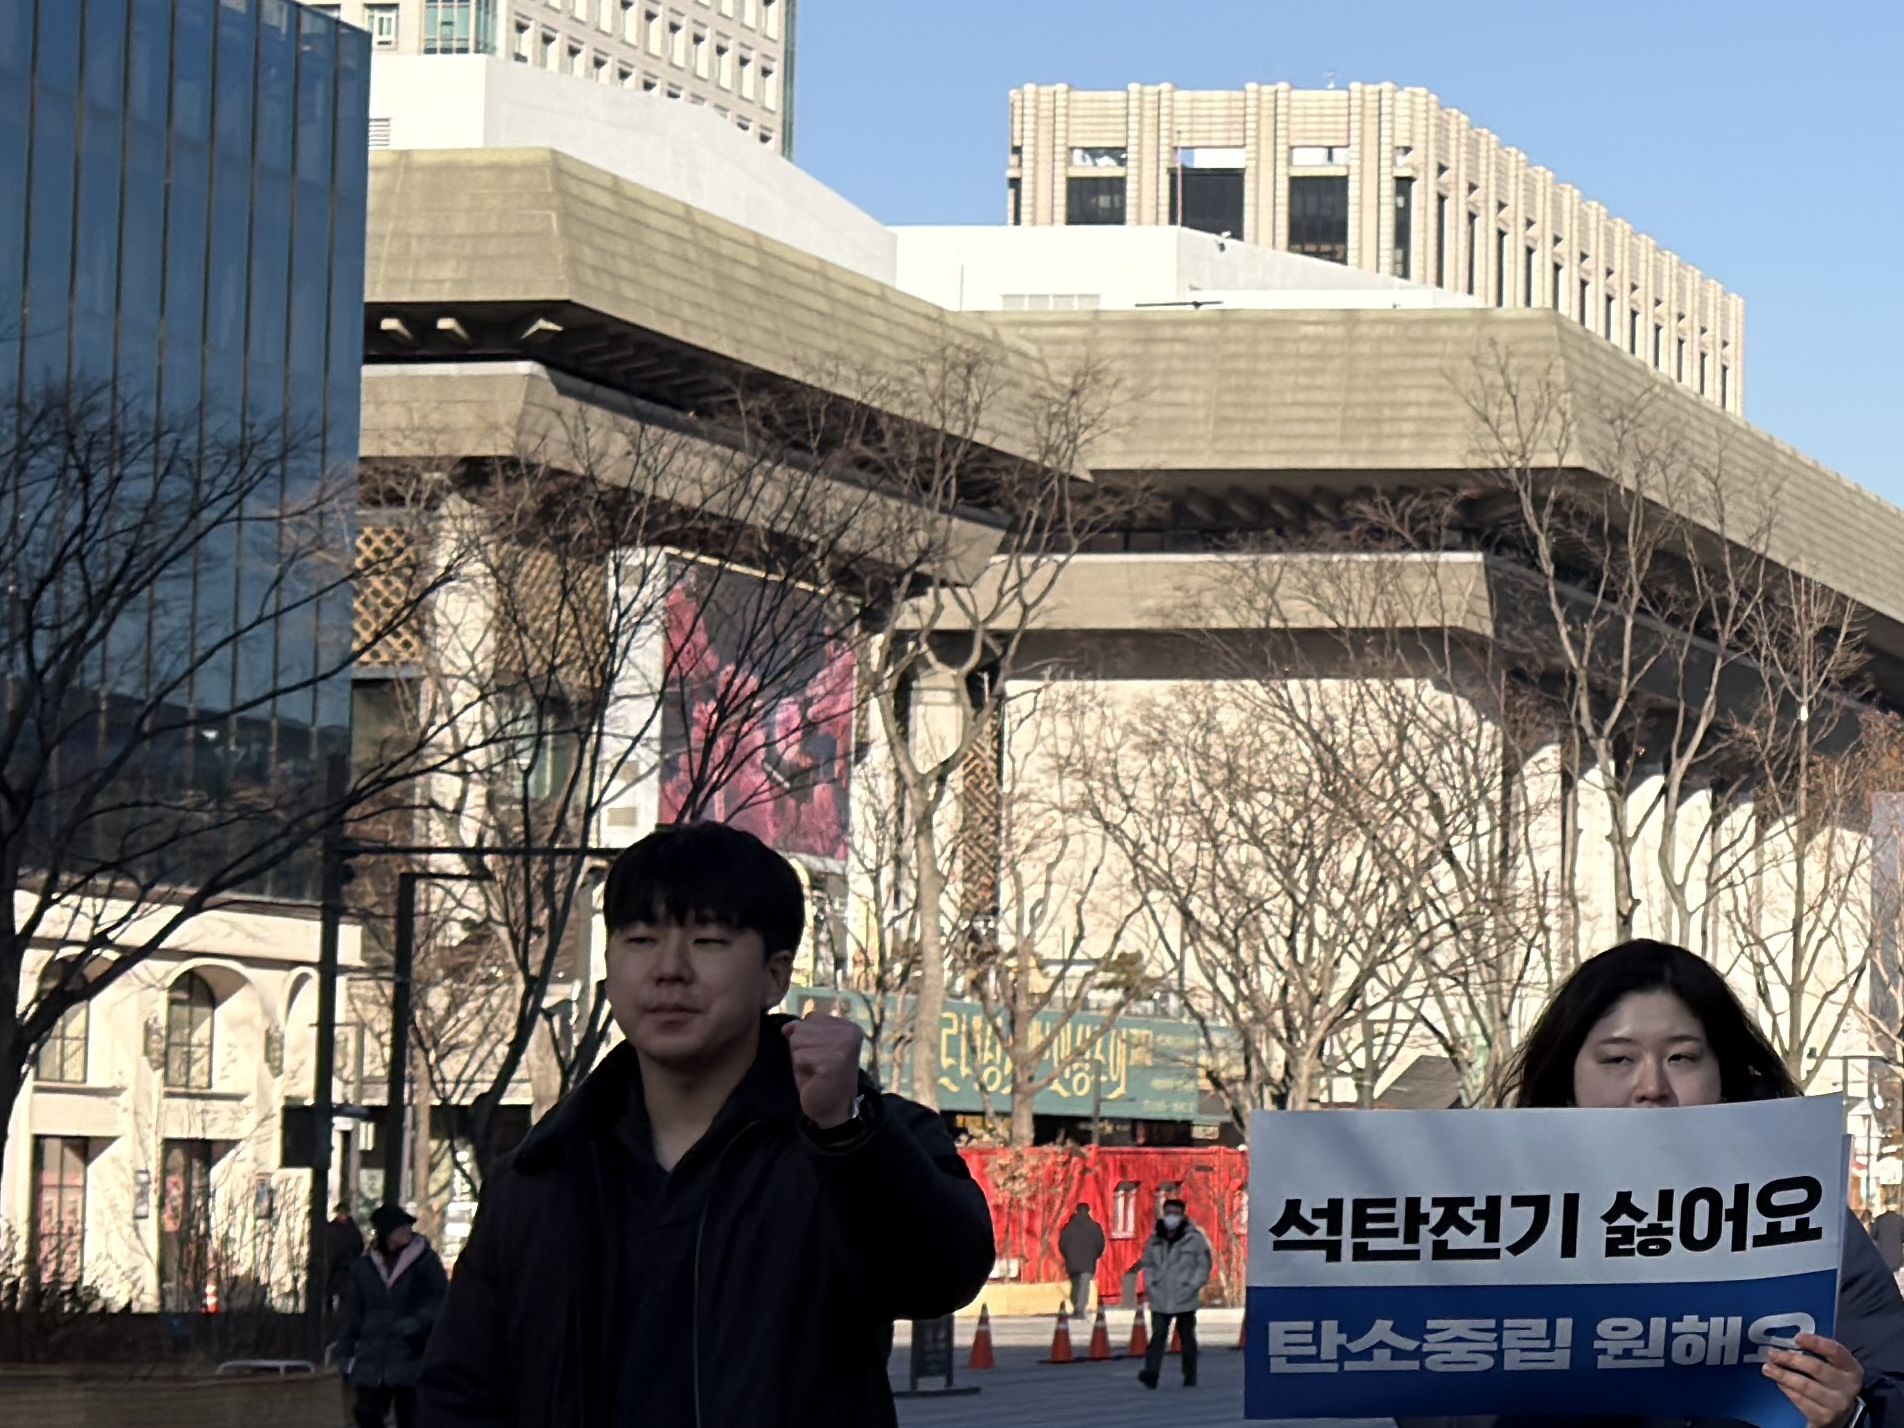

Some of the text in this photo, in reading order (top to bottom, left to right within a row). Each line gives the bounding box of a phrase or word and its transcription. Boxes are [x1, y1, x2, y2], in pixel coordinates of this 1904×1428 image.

[1268, 1175, 1823, 1263] 석탄전기 싫어요
[1268, 1311, 1817, 1373] 탄소중립 원해요
